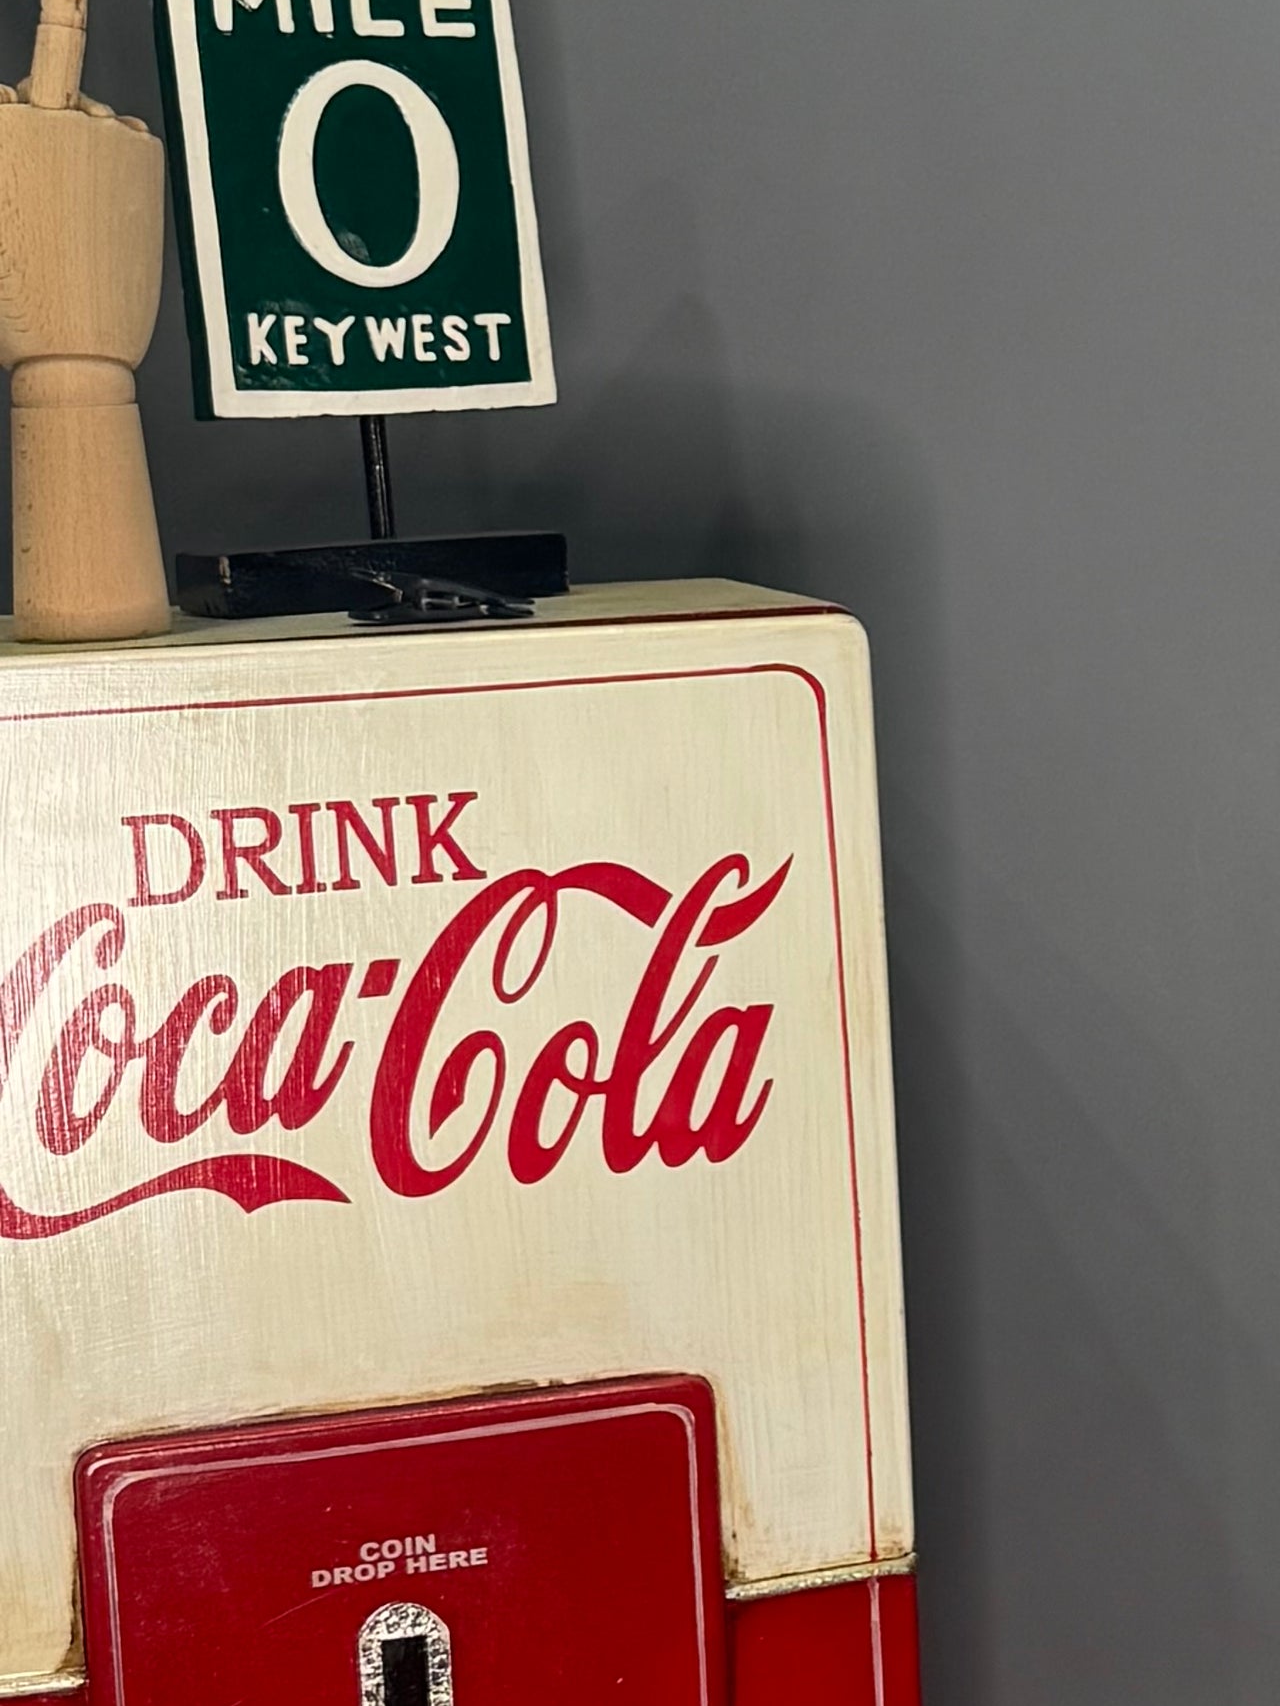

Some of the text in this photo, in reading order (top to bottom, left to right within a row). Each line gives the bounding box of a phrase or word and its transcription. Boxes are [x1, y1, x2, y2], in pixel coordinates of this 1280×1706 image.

[121, 791, 488, 907] DRINK
[0, 853, 794, 1238] Coca-Cola
[311, 1547, 489, 1588] DROP HERE
[359, 1533, 437, 1562] COIN
